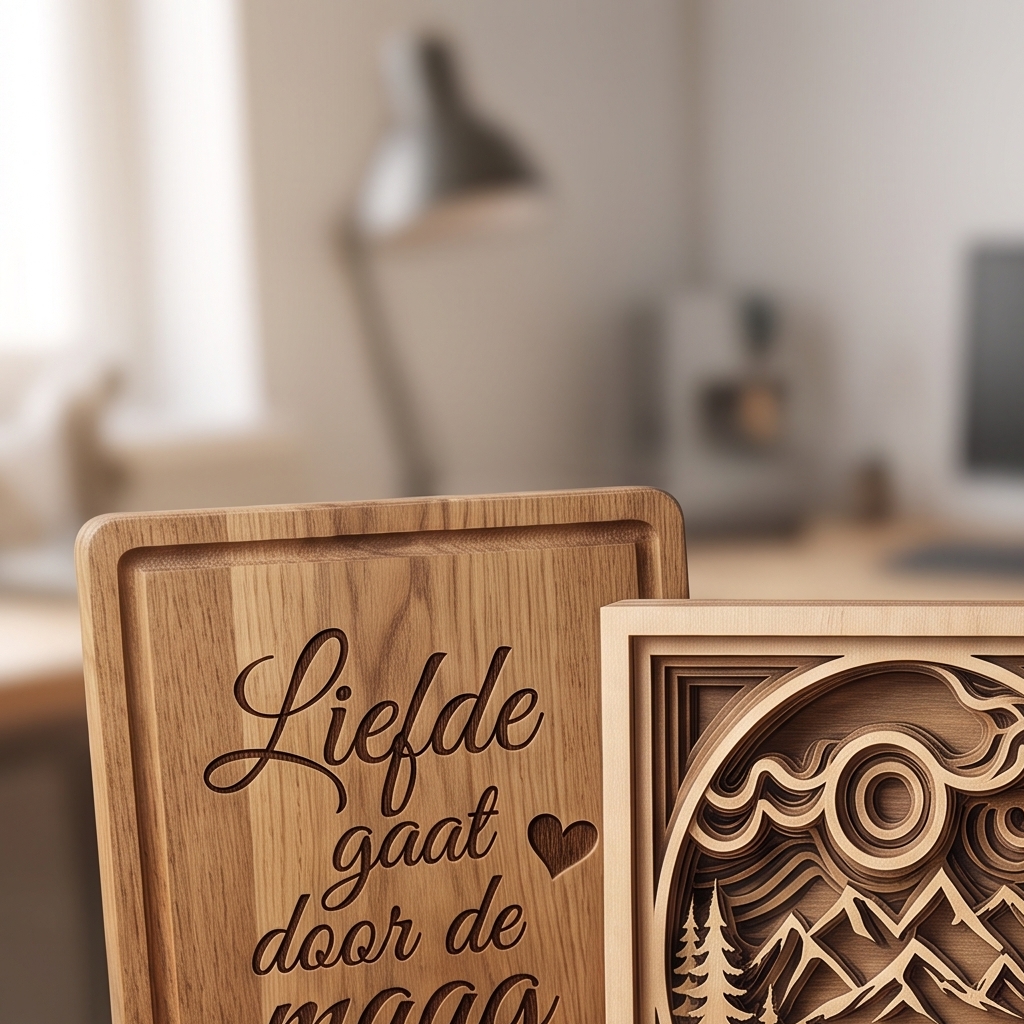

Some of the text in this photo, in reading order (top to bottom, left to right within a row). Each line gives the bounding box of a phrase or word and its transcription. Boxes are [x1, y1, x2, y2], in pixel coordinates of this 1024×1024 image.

[203, 627, 544, 817] Liefde
[321, 785, 499, 912] gaat
[252, 875, 527, 976] door de
